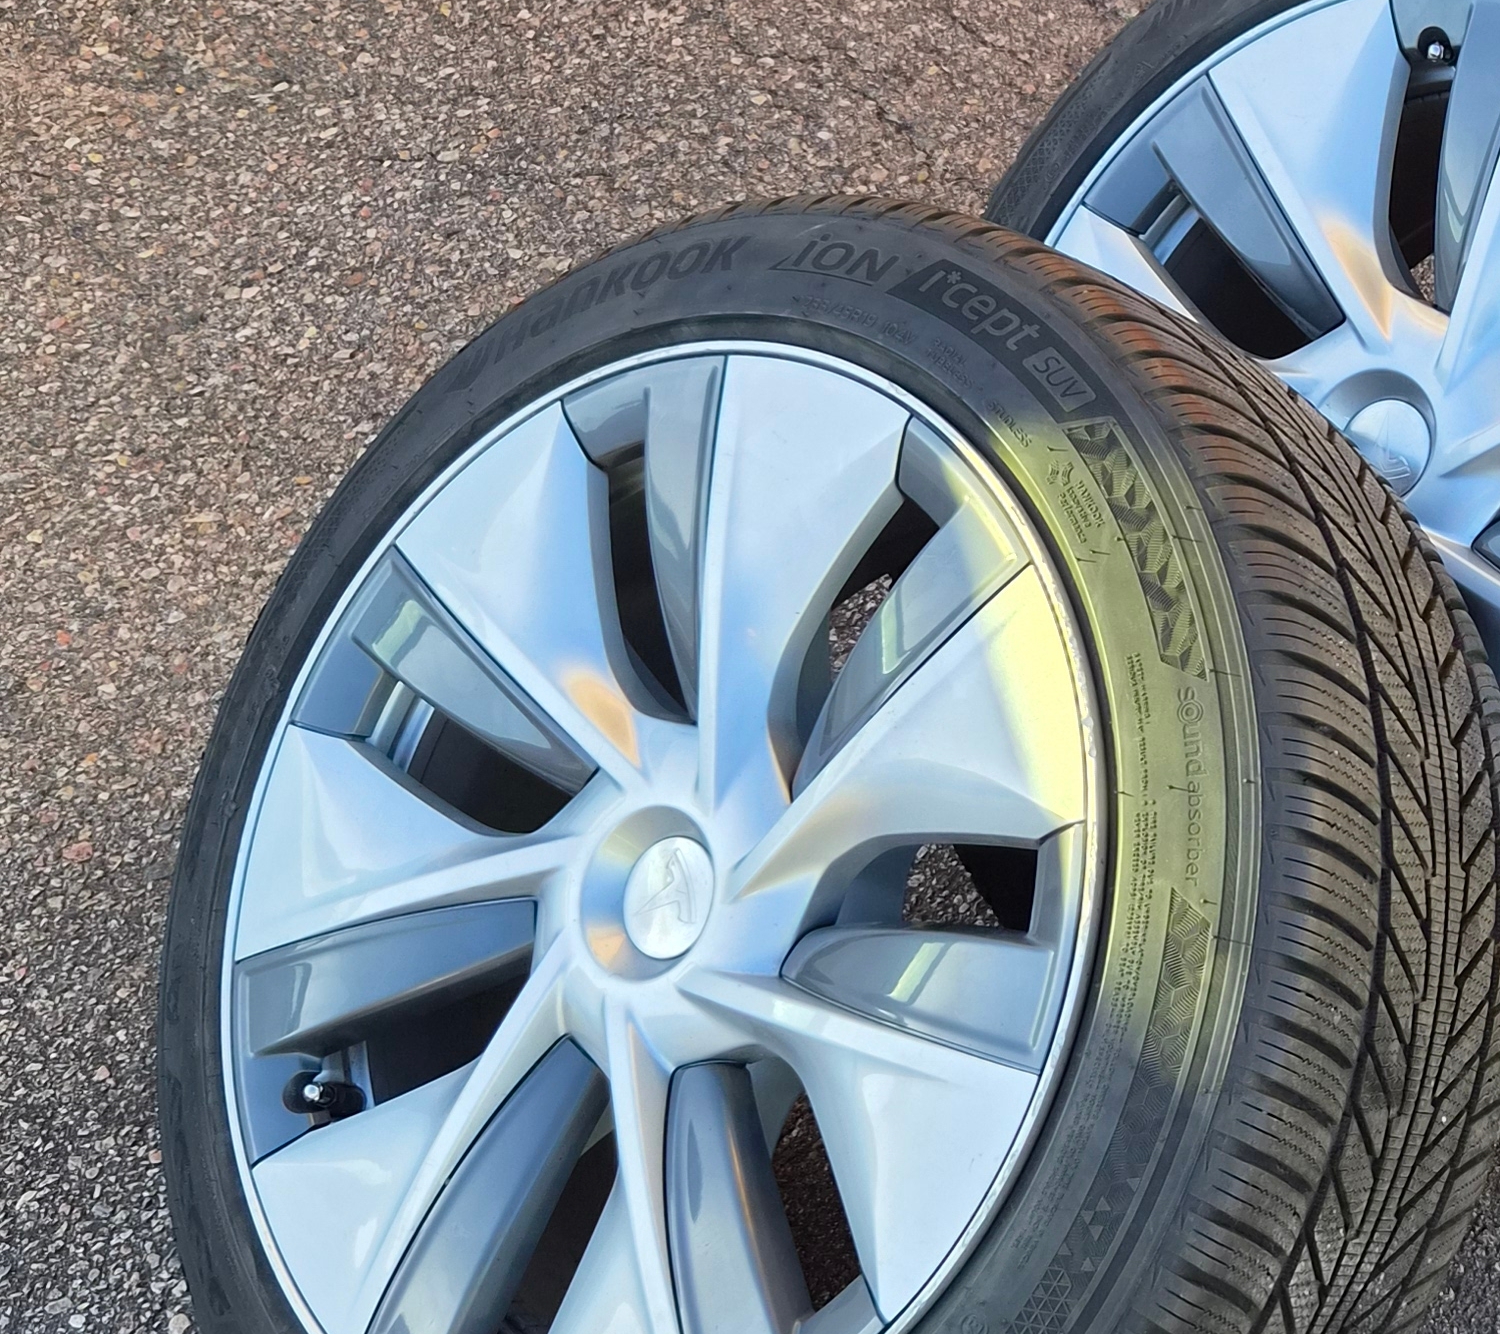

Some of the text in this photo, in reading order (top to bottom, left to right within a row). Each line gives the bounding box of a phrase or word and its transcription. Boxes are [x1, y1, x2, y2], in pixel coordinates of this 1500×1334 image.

[791, 233, 900, 283] iON
[1031, 355, 1087, 406] SUV
[1177, 686, 1208, 888] sound absorber
